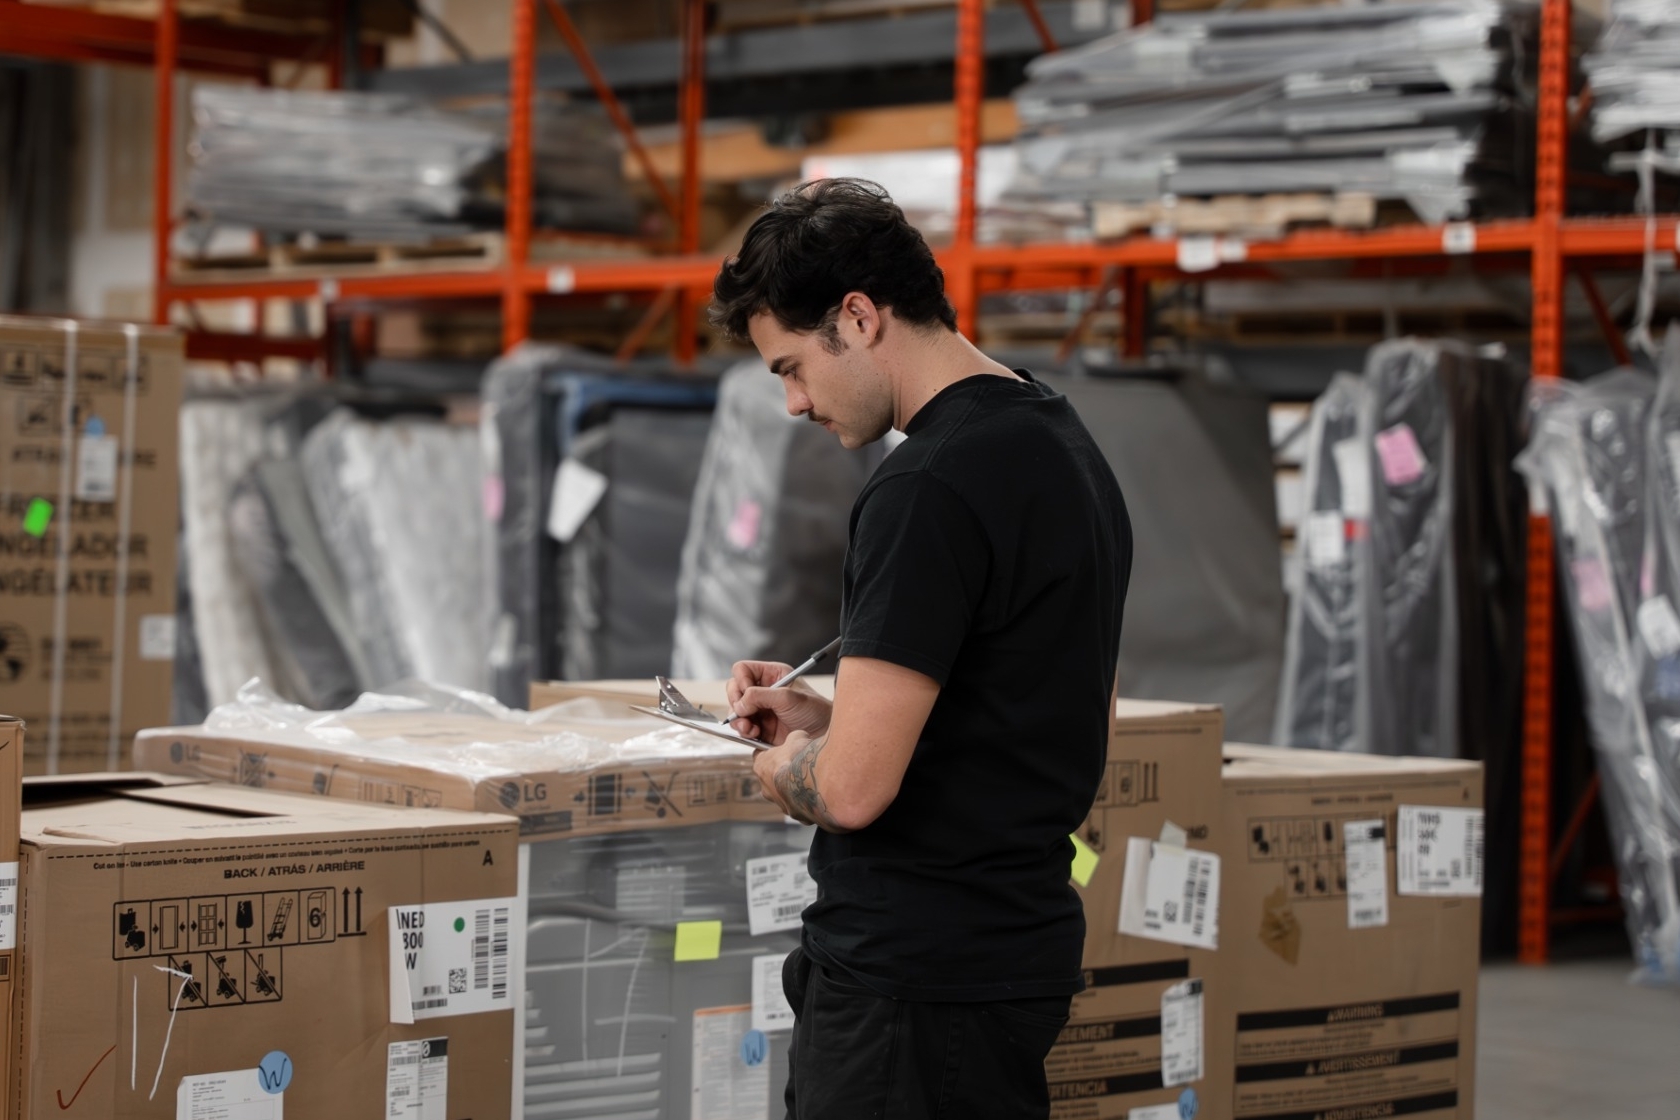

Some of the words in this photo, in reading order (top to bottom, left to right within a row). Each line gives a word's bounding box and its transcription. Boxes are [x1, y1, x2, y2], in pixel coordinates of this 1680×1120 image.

[524, 782, 547, 803] LG
[482, 849, 494, 867] A
[224, 867, 257, 879] BACK
[268, 863, 306, 876] ATRÁS
